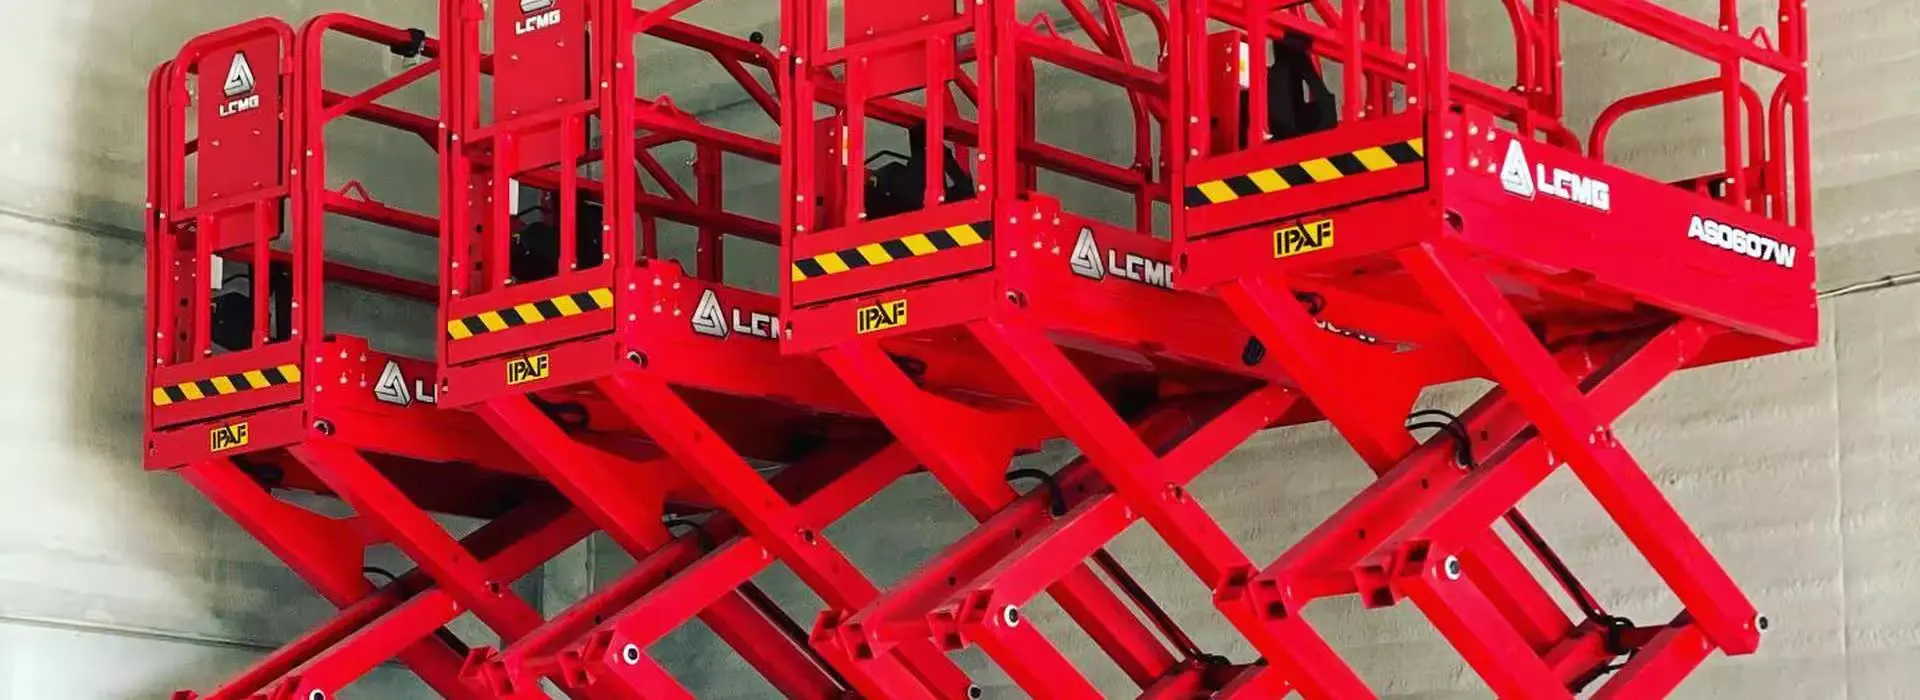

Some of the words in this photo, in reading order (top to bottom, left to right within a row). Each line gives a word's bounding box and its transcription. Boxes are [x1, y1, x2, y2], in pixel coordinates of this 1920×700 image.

[1276, 221, 1331, 255] IPAF
[859, 301, 905, 332] IPAF
[509, 355, 547, 382] IPAF
[212, 423, 246, 450] IPAF
